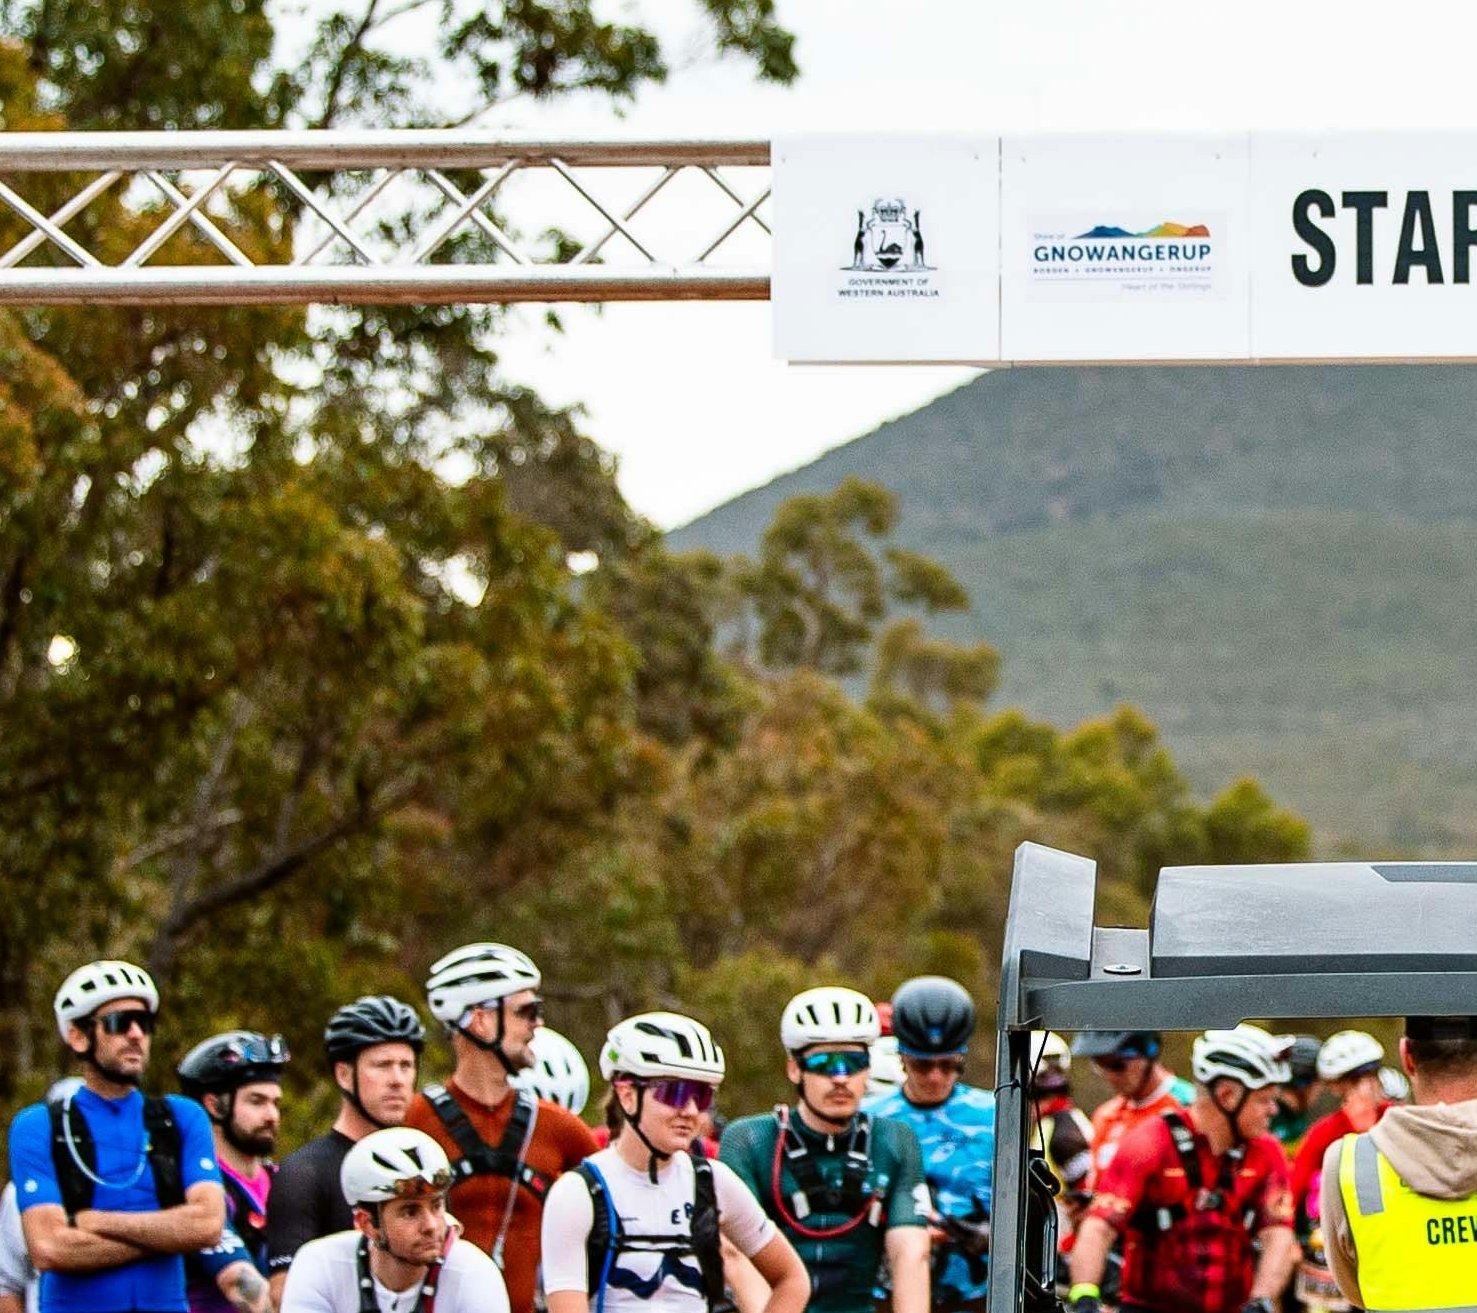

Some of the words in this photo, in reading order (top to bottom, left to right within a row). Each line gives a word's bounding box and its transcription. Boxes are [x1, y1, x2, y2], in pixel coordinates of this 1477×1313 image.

[1034, 244, 1211, 261] GNOWANGERUP
[848, 278, 913, 286] GOVERNMENT
[916, 278, 929, 286] OF
[838, 289, 884, 297] WESTERN
[887, 289, 940, 297] AUSTRALIA
